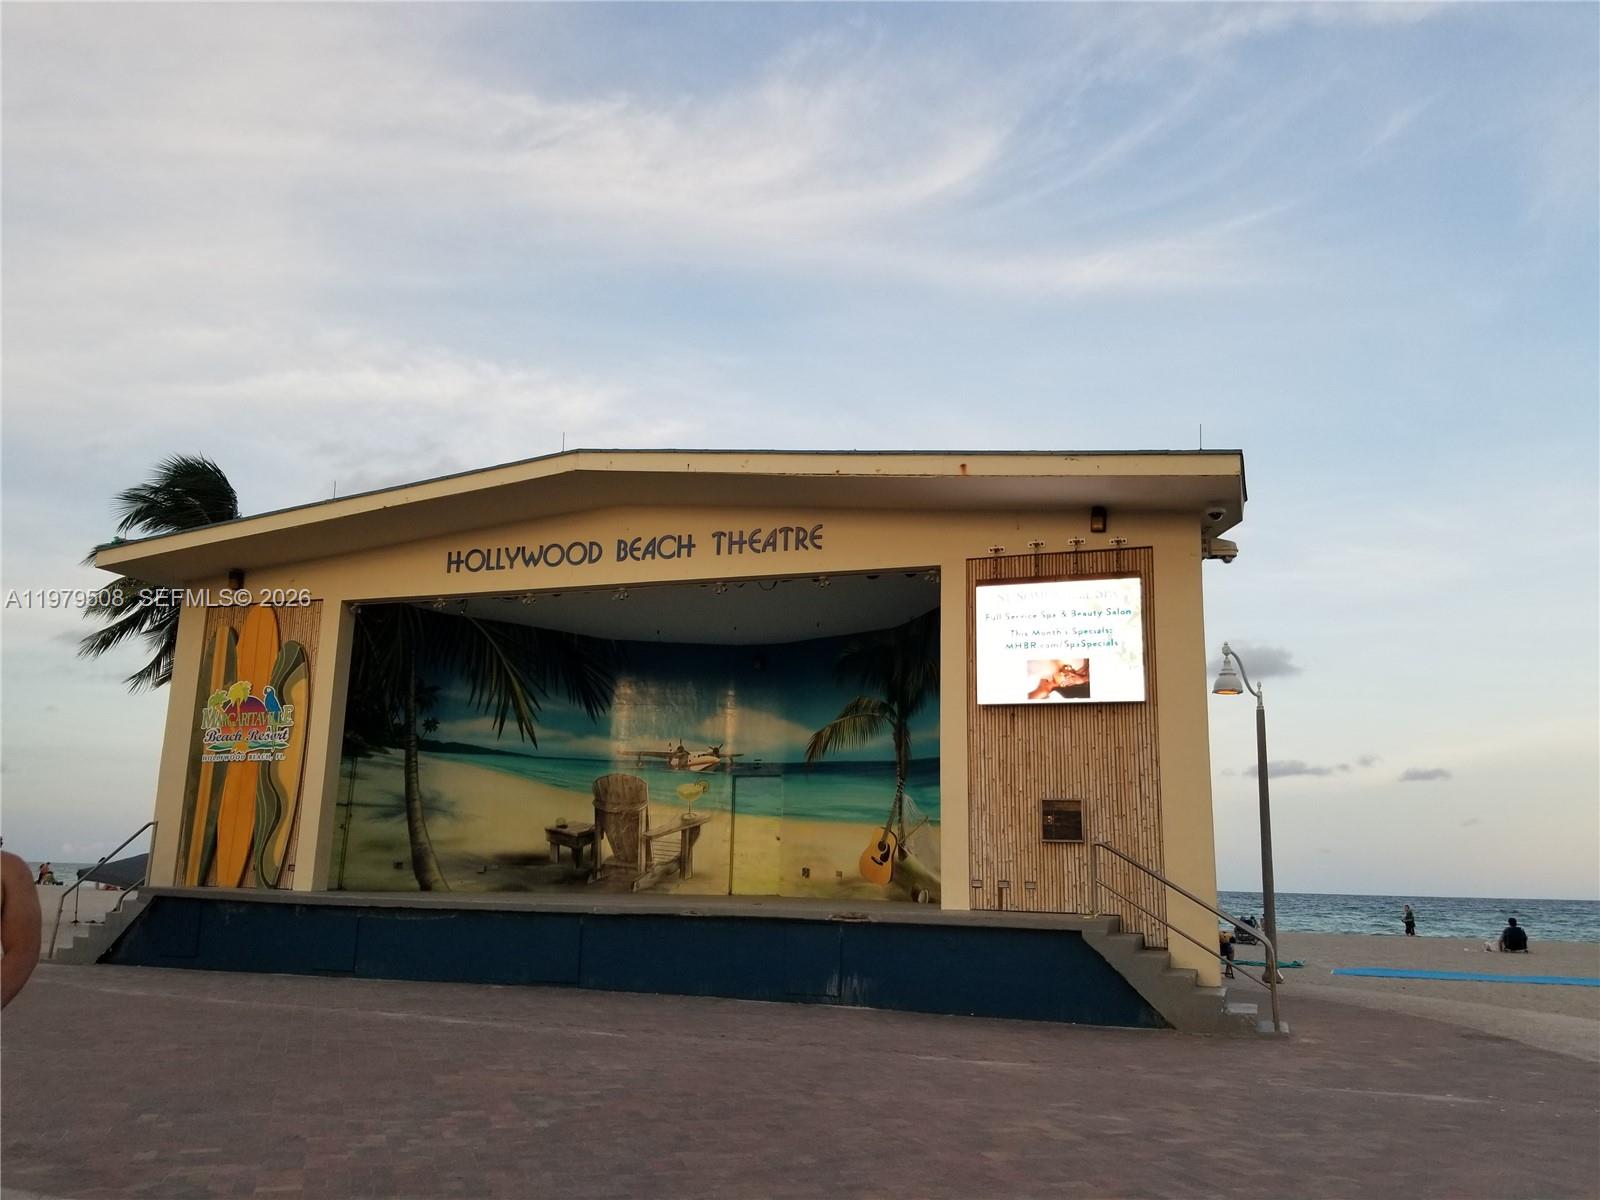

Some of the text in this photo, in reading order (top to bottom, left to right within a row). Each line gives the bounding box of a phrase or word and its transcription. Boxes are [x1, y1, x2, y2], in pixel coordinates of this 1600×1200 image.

[446, 524, 824, 573] HOLLYWOOD BEACH THEATRE
[985, 612, 1002, 622] Full
[1041, 610, 1056, 620] Spa
[1071, 608, 1102, 619] Beauty
[1105, 607, 1132, 616] Salon
[1010, 629, 1028, 637] This
[1031, 627, 1069, 636] Months
[201, 705, 294, 730] MARGARITAVILLE
[204, 727, 290, 744] Beach Resort
[202, 752, 246, 762] HOLLYWOOD
[247, 752, 274, 762] BEACH,
